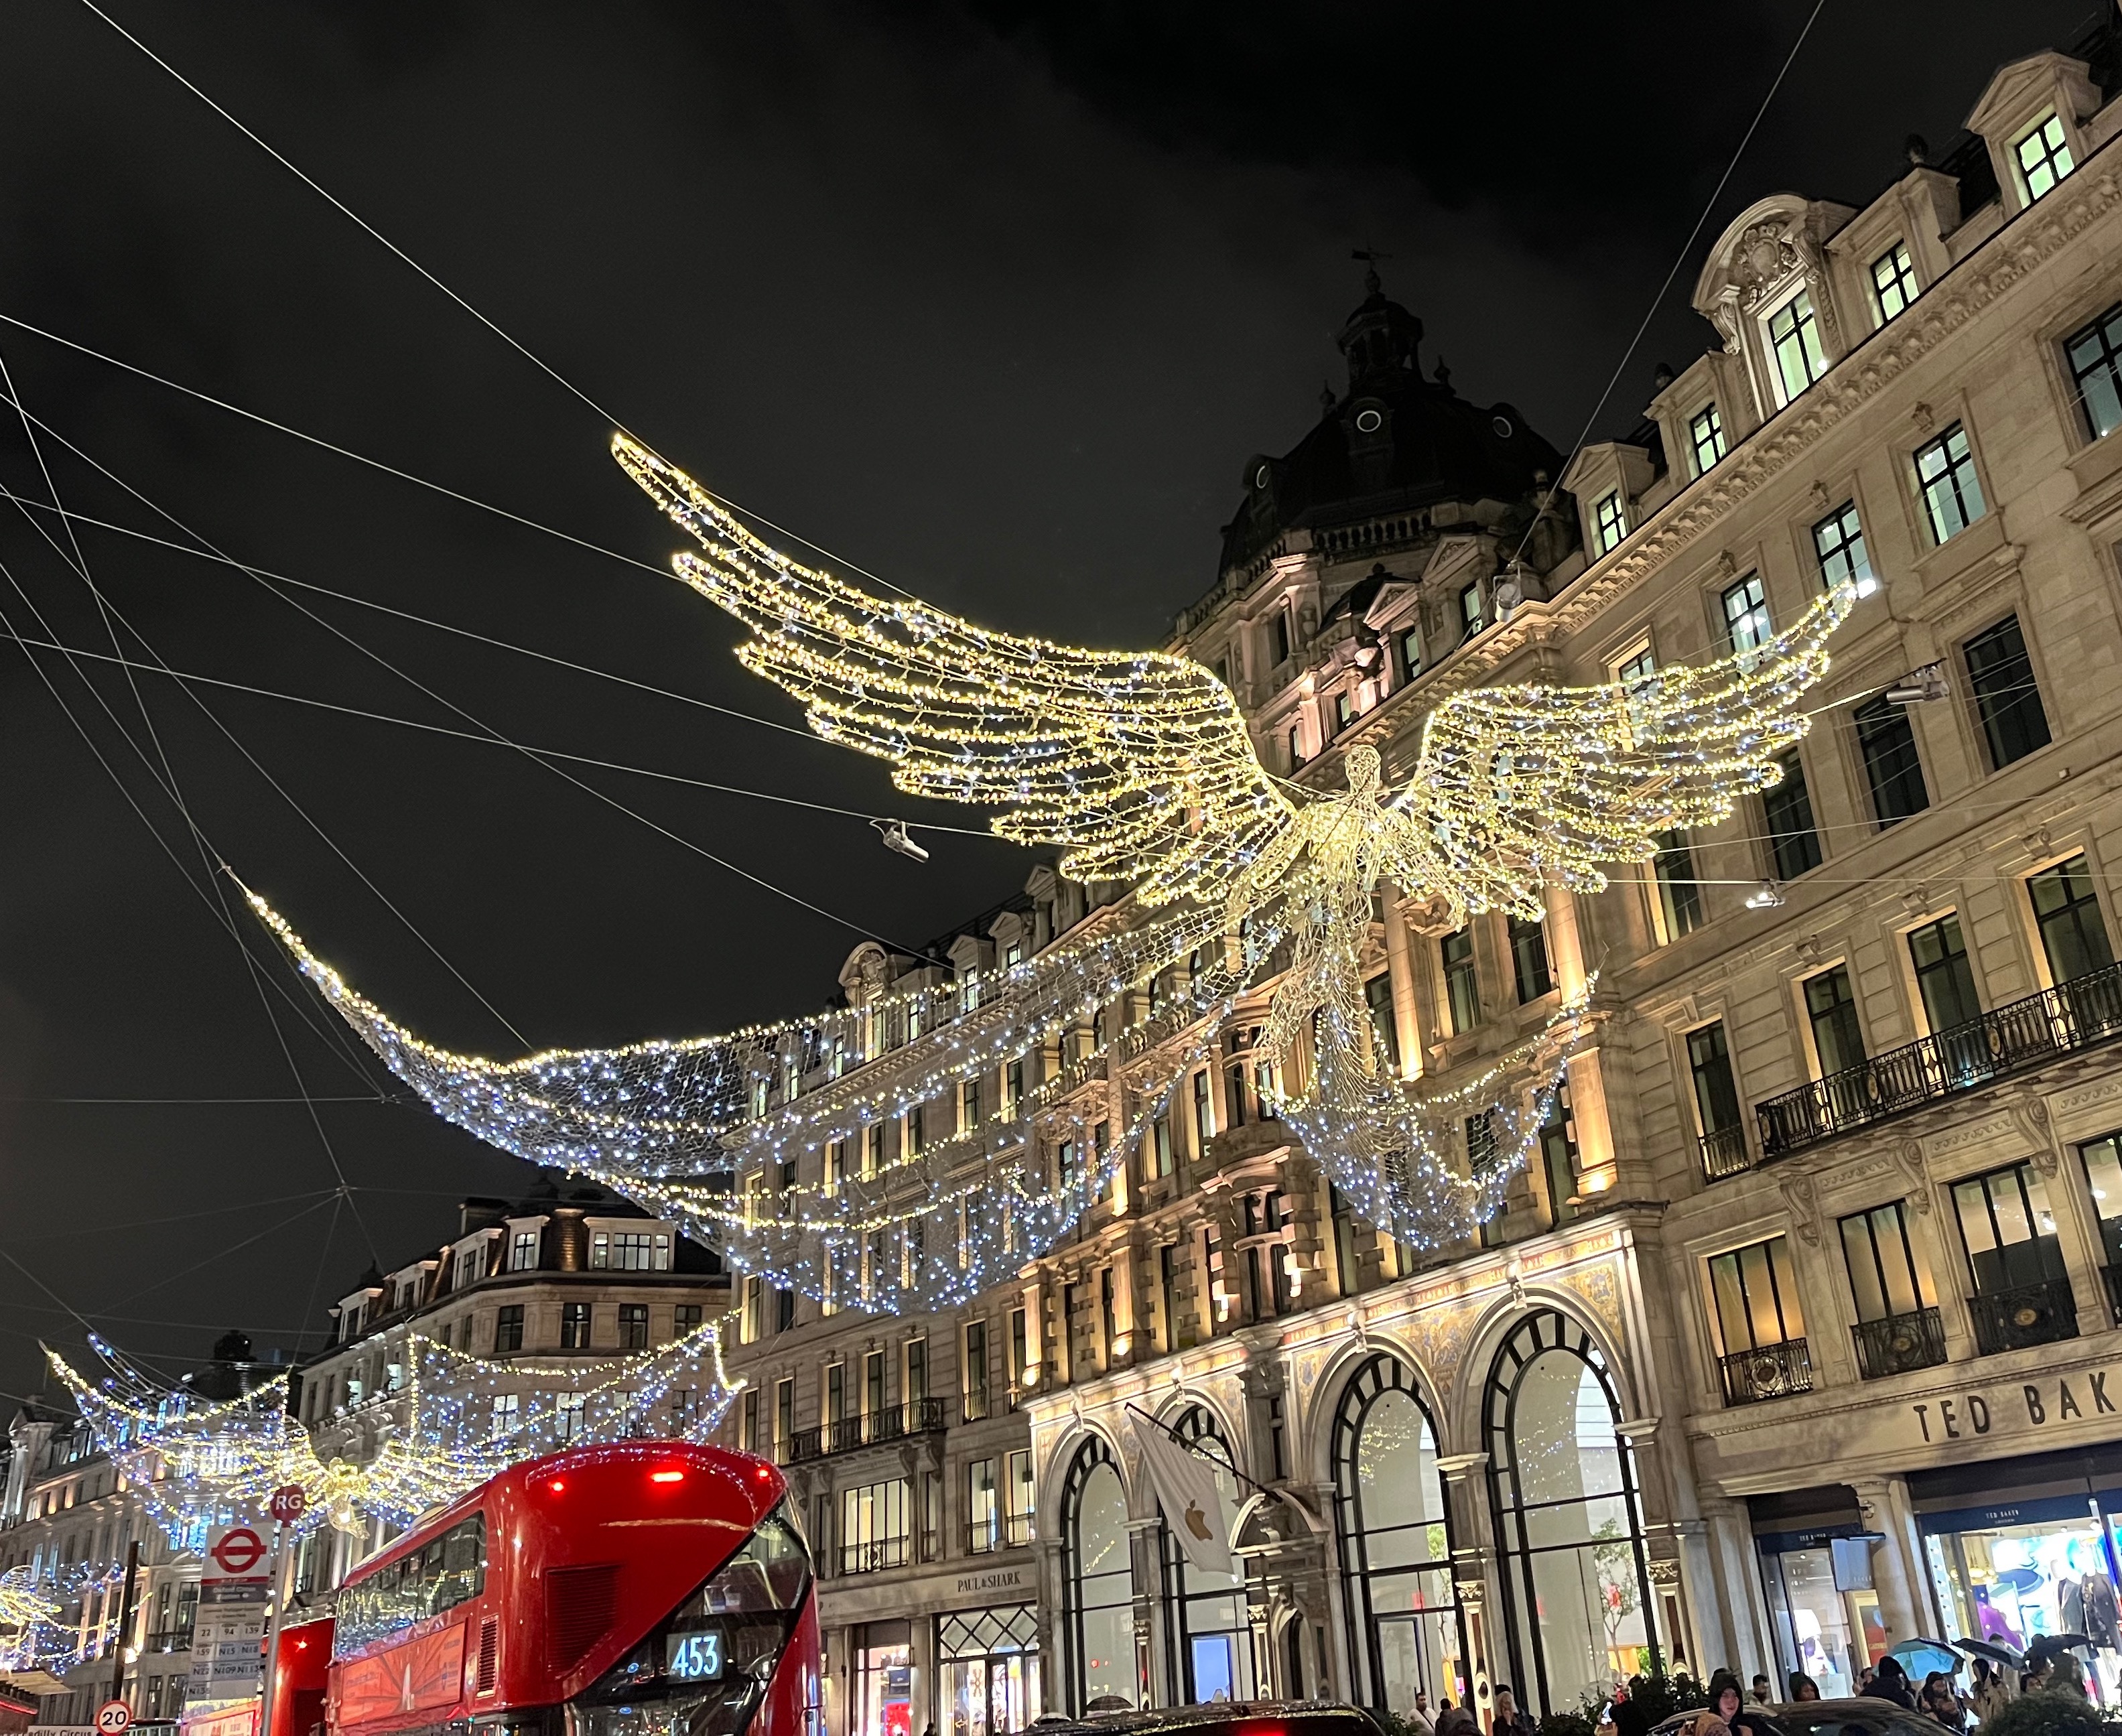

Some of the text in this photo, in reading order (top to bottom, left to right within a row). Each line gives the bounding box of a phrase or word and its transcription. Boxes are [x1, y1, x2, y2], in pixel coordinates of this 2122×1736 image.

[1913, 1372, 2117, 1443] TED BAK
[275, 1493, 302, 1511] RG
[957, 1577, 981, 1593] PAUL
[988, 1571, 1021, 1589] SHARK
[201, 1629, 211, 1637] 22
[218, 1647, 235, 1656] N15
[241, 1646, 259, 1654] N18
[671, 1635, 718, 1678] 453
[214, 1666, 237, 1674] N109
[102, 1711, 127, 1727] 20
